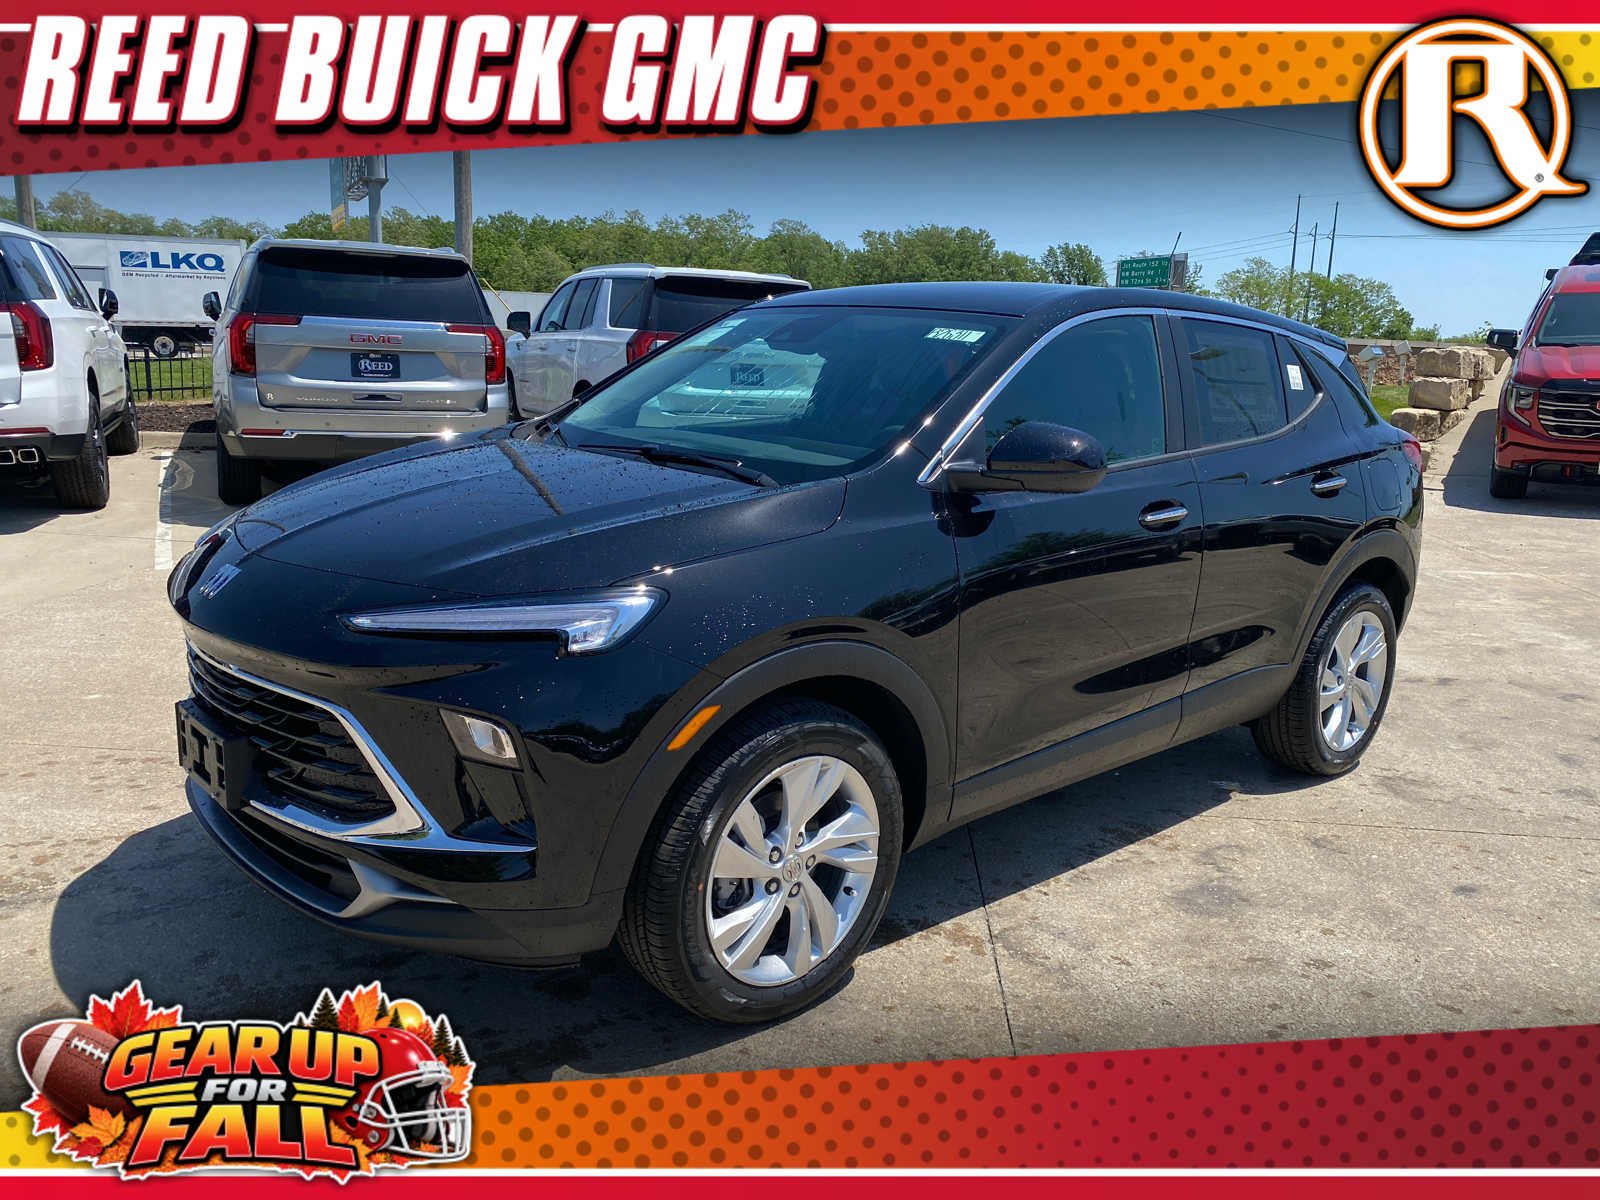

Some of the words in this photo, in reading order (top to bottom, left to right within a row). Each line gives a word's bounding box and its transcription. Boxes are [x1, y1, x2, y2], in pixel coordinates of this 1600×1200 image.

[150, 251, 225, 272] LKQ
[350, 334, 403, 344] GMC
[358, 358, 393, 372] REED
